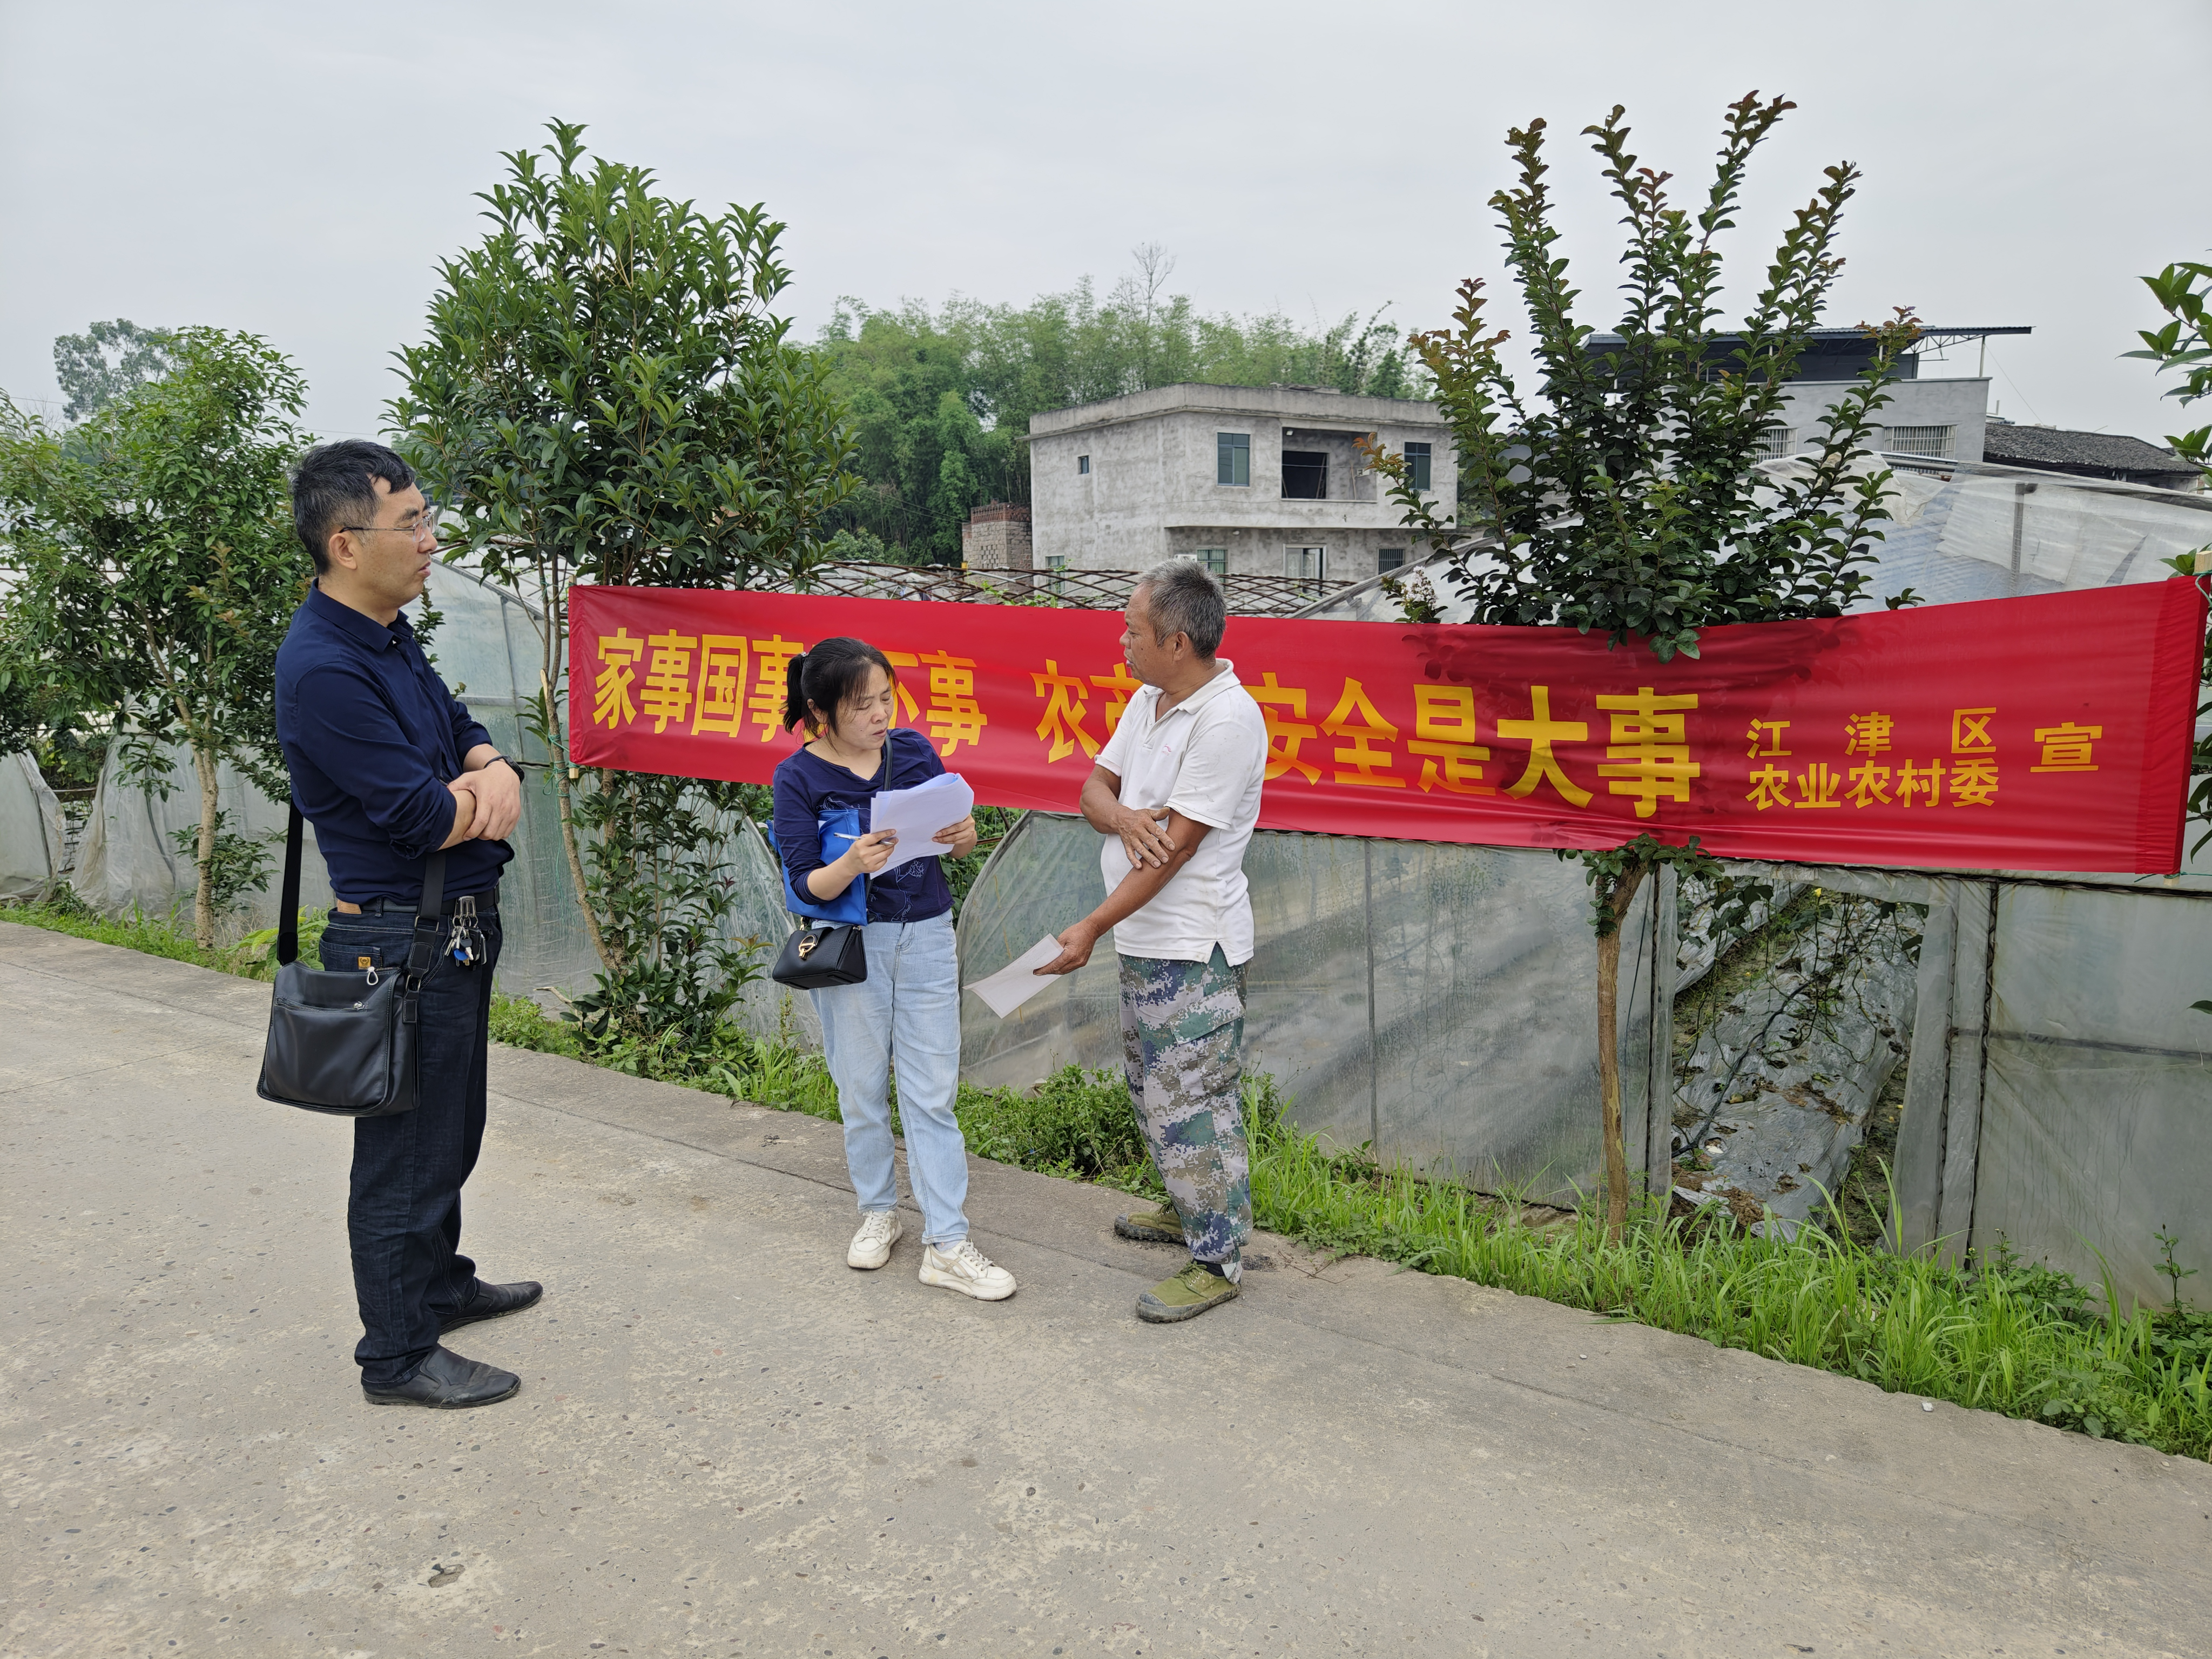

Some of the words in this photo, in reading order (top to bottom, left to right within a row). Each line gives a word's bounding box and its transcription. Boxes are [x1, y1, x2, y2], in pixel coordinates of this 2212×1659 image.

[592, 627, 988, 757] 家事国事下事
[1029, 658, 1701, 818] 农产安全是大事
[1745, 707, 1997, 759] 江津区
[2029, 721, 2103, 773] 宣
[1745, 757, 1999, 811] 农业农村委
